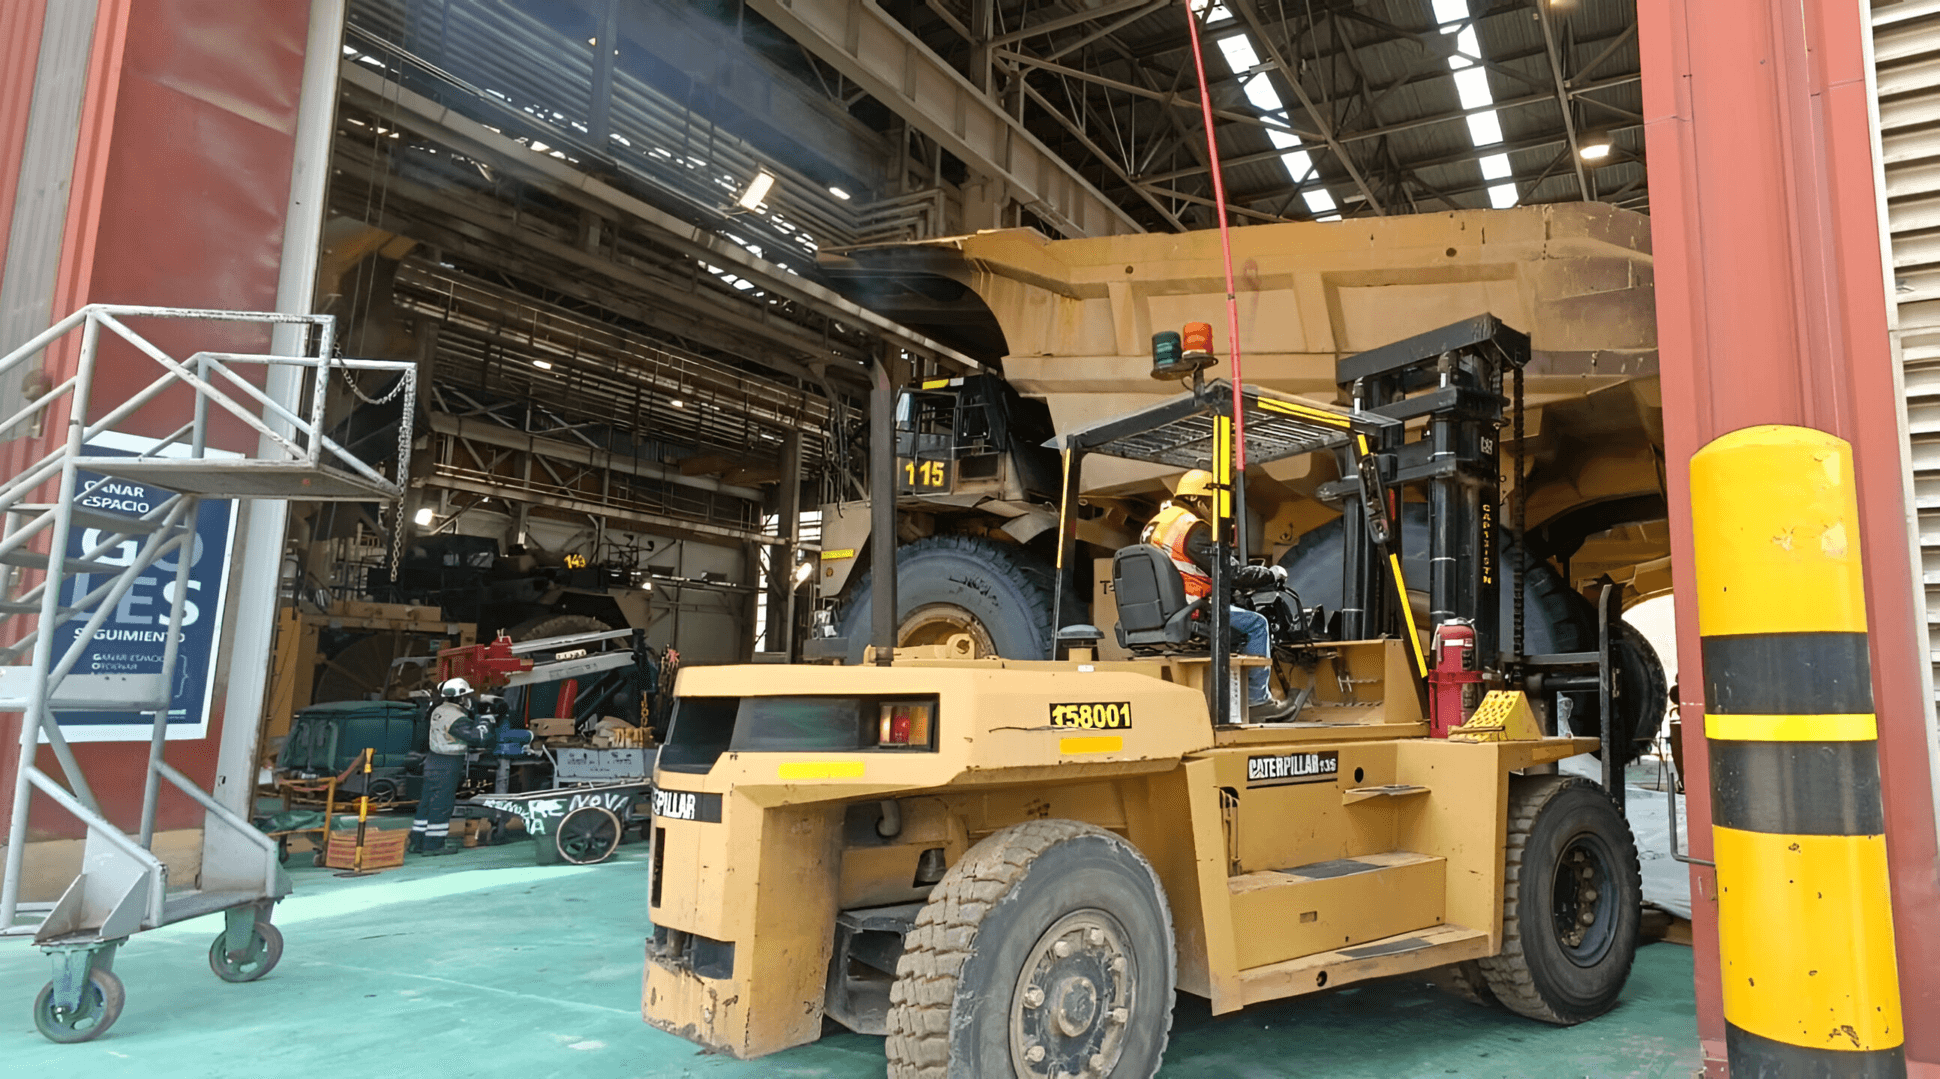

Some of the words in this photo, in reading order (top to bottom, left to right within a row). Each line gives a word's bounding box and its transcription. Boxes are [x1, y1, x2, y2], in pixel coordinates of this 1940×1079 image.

[905, 461, 945, 487] 115
[82, 496, 149, 513] ESPACIO
[73, 627, 186, 643] SGUIMIENO
[1249, 754, 1319, 779] CATERPILLAR
